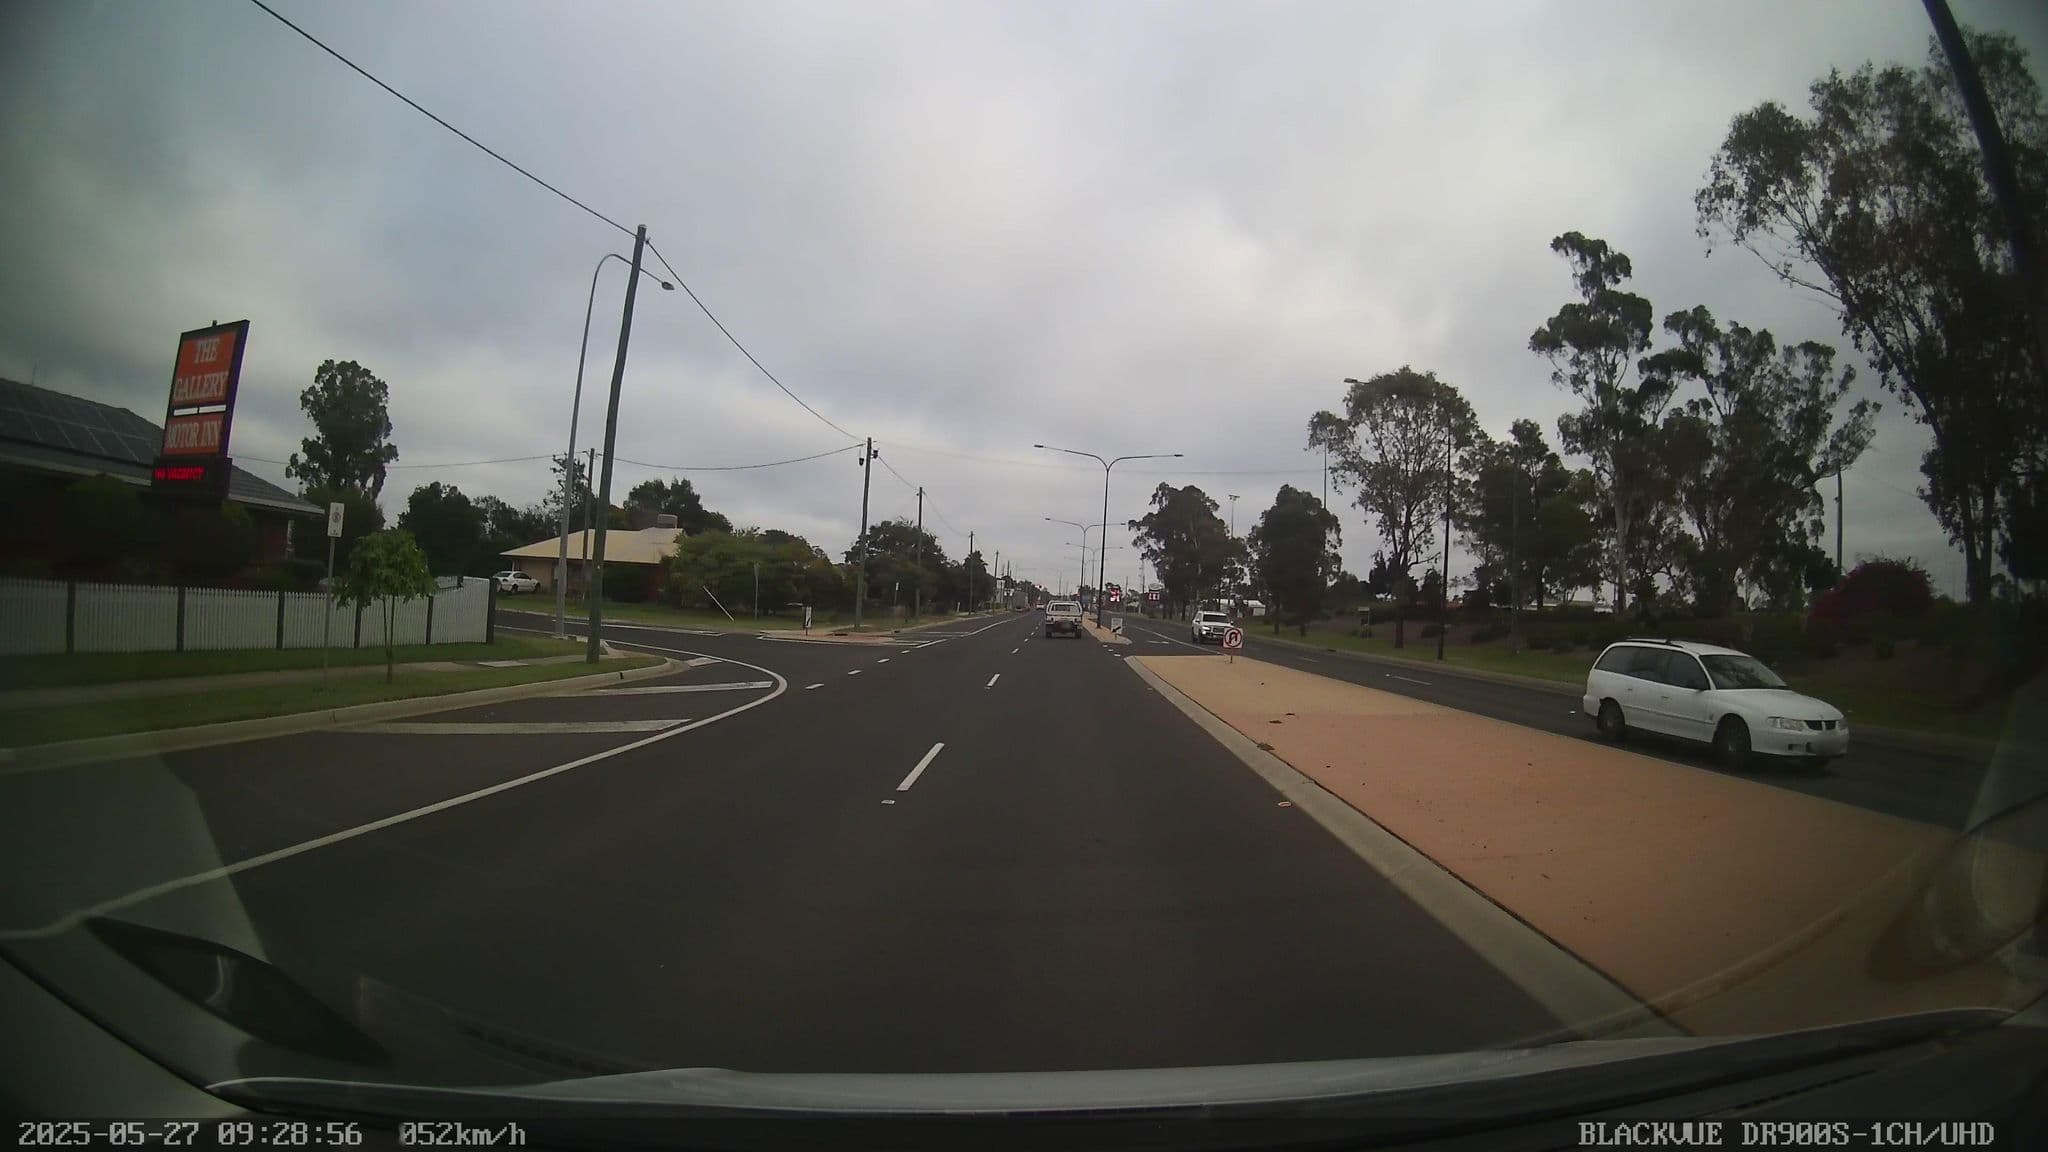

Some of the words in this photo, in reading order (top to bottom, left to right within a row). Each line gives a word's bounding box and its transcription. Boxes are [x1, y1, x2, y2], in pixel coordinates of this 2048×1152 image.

[194, 338, 221, 363] THE
[173, 371, 229, 401] GALLERY
[166, 423, 199, 449] MOTOR
[201, 420, 222, 447] INN
